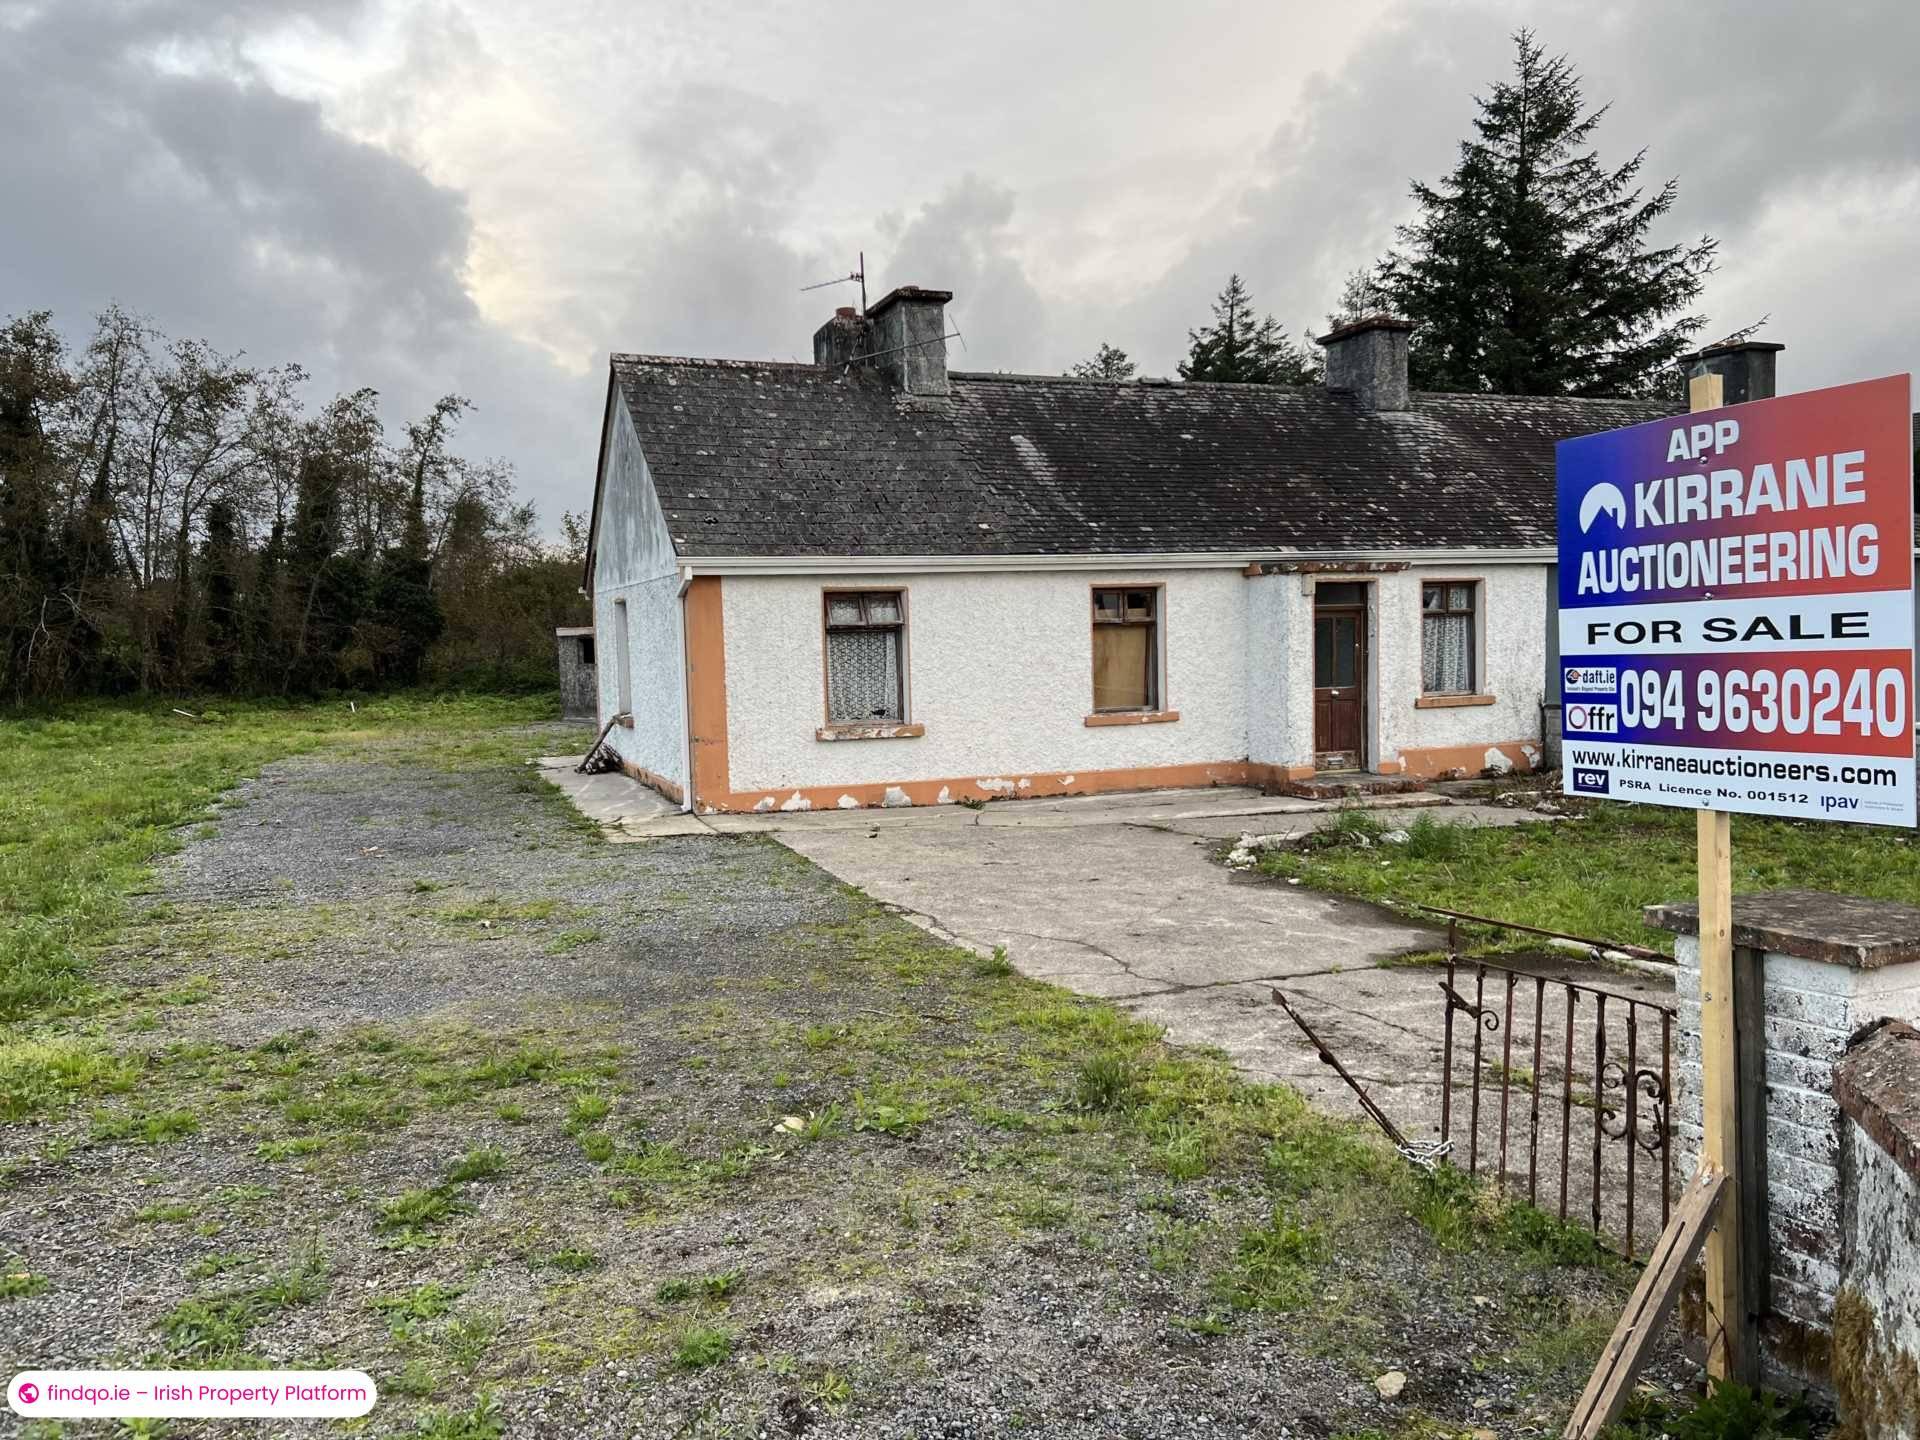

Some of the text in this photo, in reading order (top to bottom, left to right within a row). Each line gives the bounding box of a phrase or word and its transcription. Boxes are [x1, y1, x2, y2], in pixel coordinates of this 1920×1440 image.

[1666, 419, 1740, 463] APP
[1634, 450, 1866, 529] KIRRANE
[1577, 523, 1879, 595] AUCTIONEERING
[1588, 611, 1870, 645] FOR SALE
[1582, 669, 1615, 684] daft.ie
[1620, 668, 1906, 738] 094 9630240
[1572, 748, 1897, 787] www.kirraneauctioneers.com
[1577, 771, 1606, 786] rev
[1619, 779, 1809, 804] PSRA Licence No. 001512
